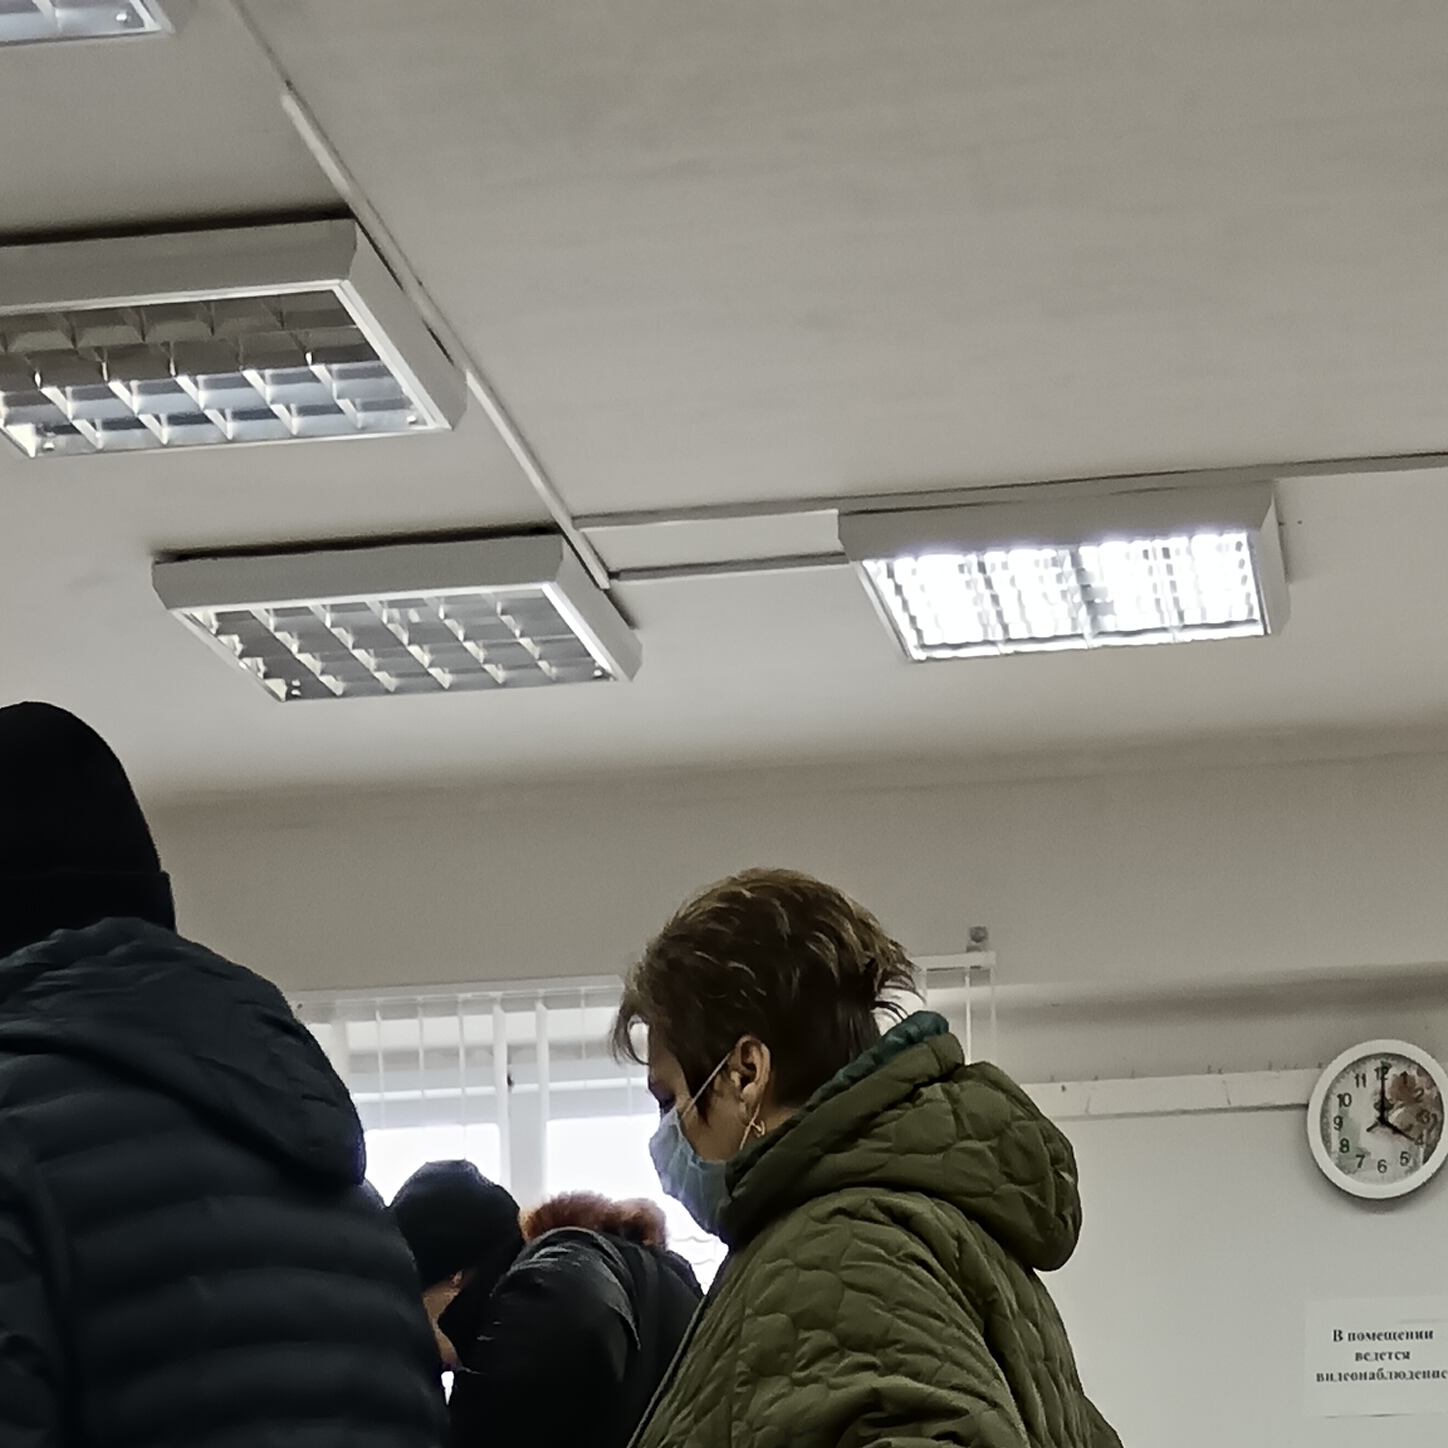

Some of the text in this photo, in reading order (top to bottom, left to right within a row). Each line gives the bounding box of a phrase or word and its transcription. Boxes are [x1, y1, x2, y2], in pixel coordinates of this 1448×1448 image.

[1333, 1329, 1434, 1342] В помещении
[1316, 1367, 1448, 1382] видеонаблюдение
